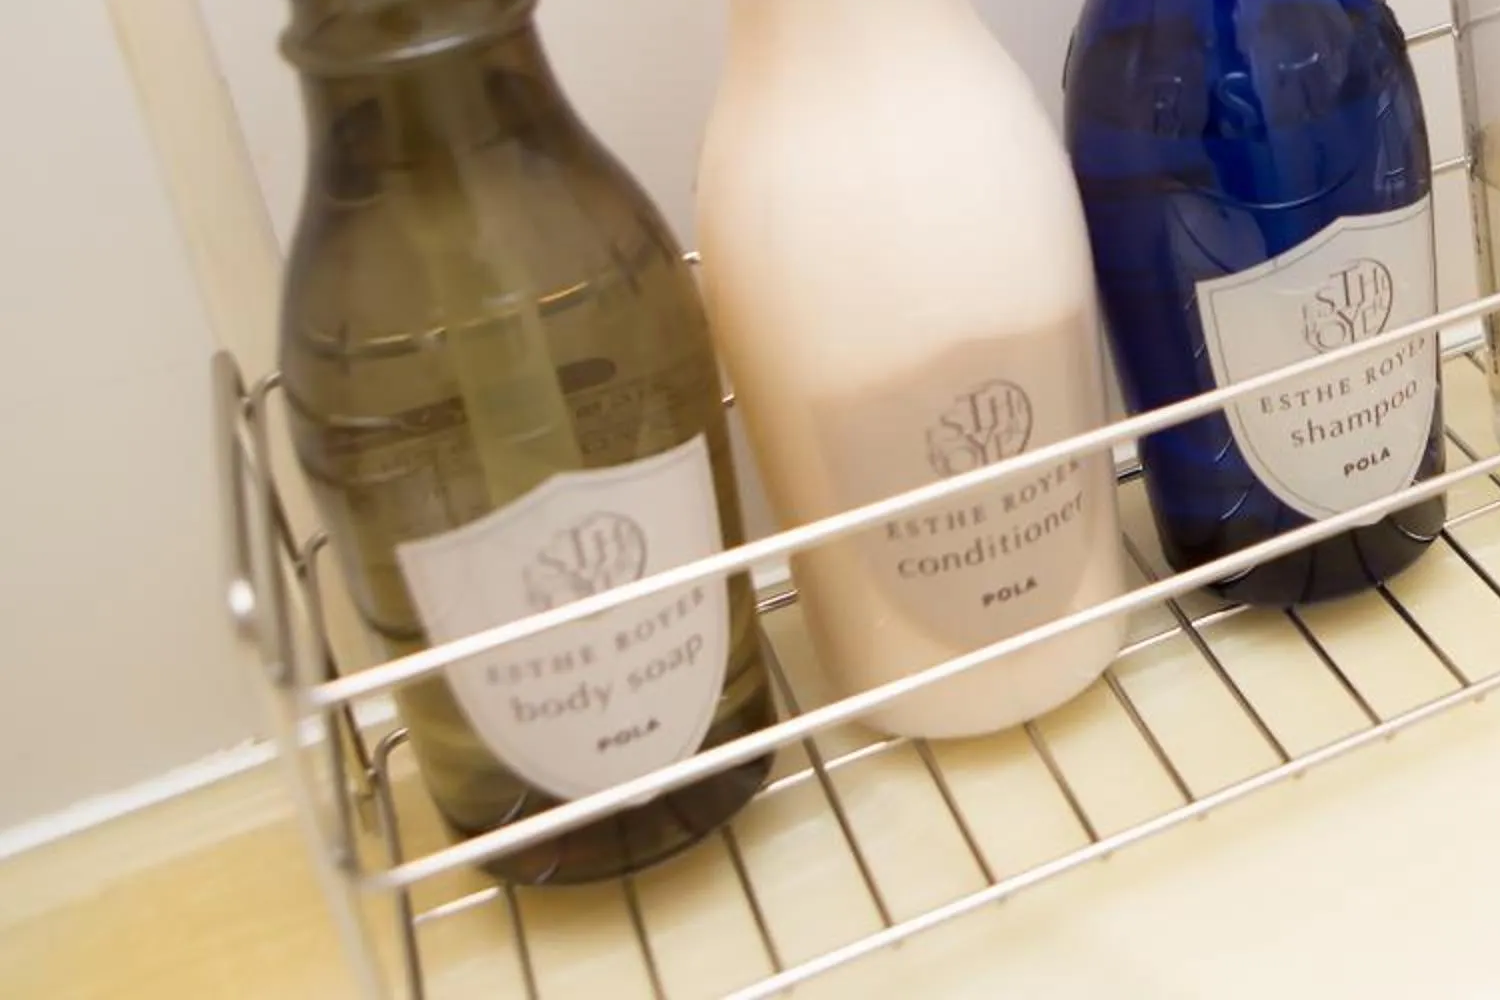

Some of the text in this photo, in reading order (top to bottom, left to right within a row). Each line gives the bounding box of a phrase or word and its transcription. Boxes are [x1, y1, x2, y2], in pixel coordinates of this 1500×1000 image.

[1259, 377, 1351, 415] ESTHE
[1290, 379, 1418, 447] shampoo
[1342, 447, 1392, 478] POLA
[886, 505, 987, 541] ESTHE
[981, 574, 1039, 608] POLA
[510, 632, 705, 724] body soap
[596, 716, 661, 752] POLA
